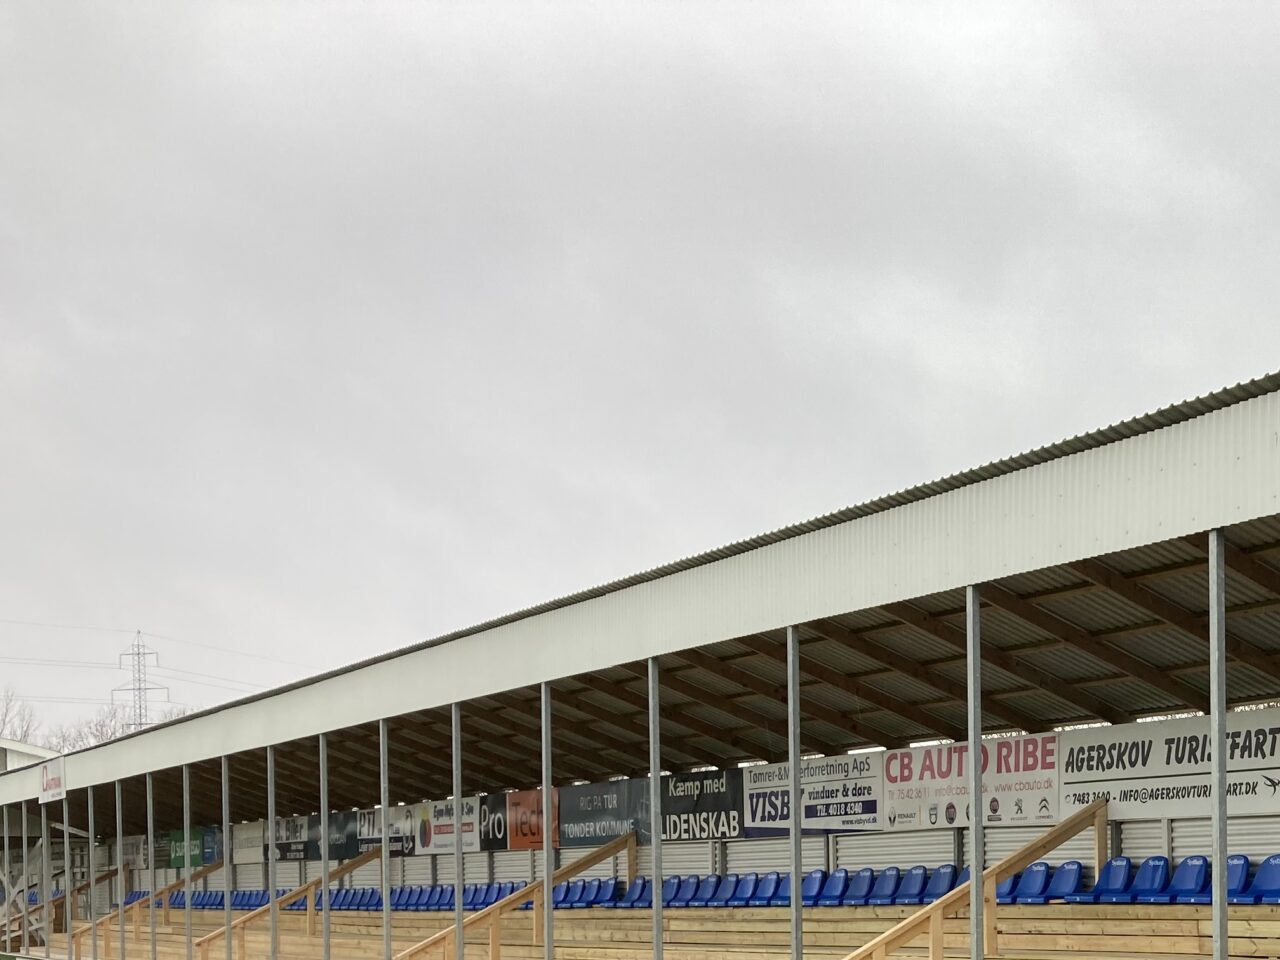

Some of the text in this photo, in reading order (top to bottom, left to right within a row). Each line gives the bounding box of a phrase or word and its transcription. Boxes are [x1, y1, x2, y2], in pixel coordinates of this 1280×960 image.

[885, 752, 913, 783] CB
[996, 736, 1057, 774] RIBE
[1065, 727, 1280, 773] AGERSKOV TURIFART
[852, 757, 870, 776] ApS
[669, 771, 726, 800] Kæmp med
[1072, 792, 1090, 805] 7483
[603, 794, 617, 809] TUR
[749, 783, 872, 822] VISB vinduer & døre
[829, 804, 845, 815] 4018
[481, 805, 504, 839] Pro
[661, 810, 739, 840] LIDENSKAB
